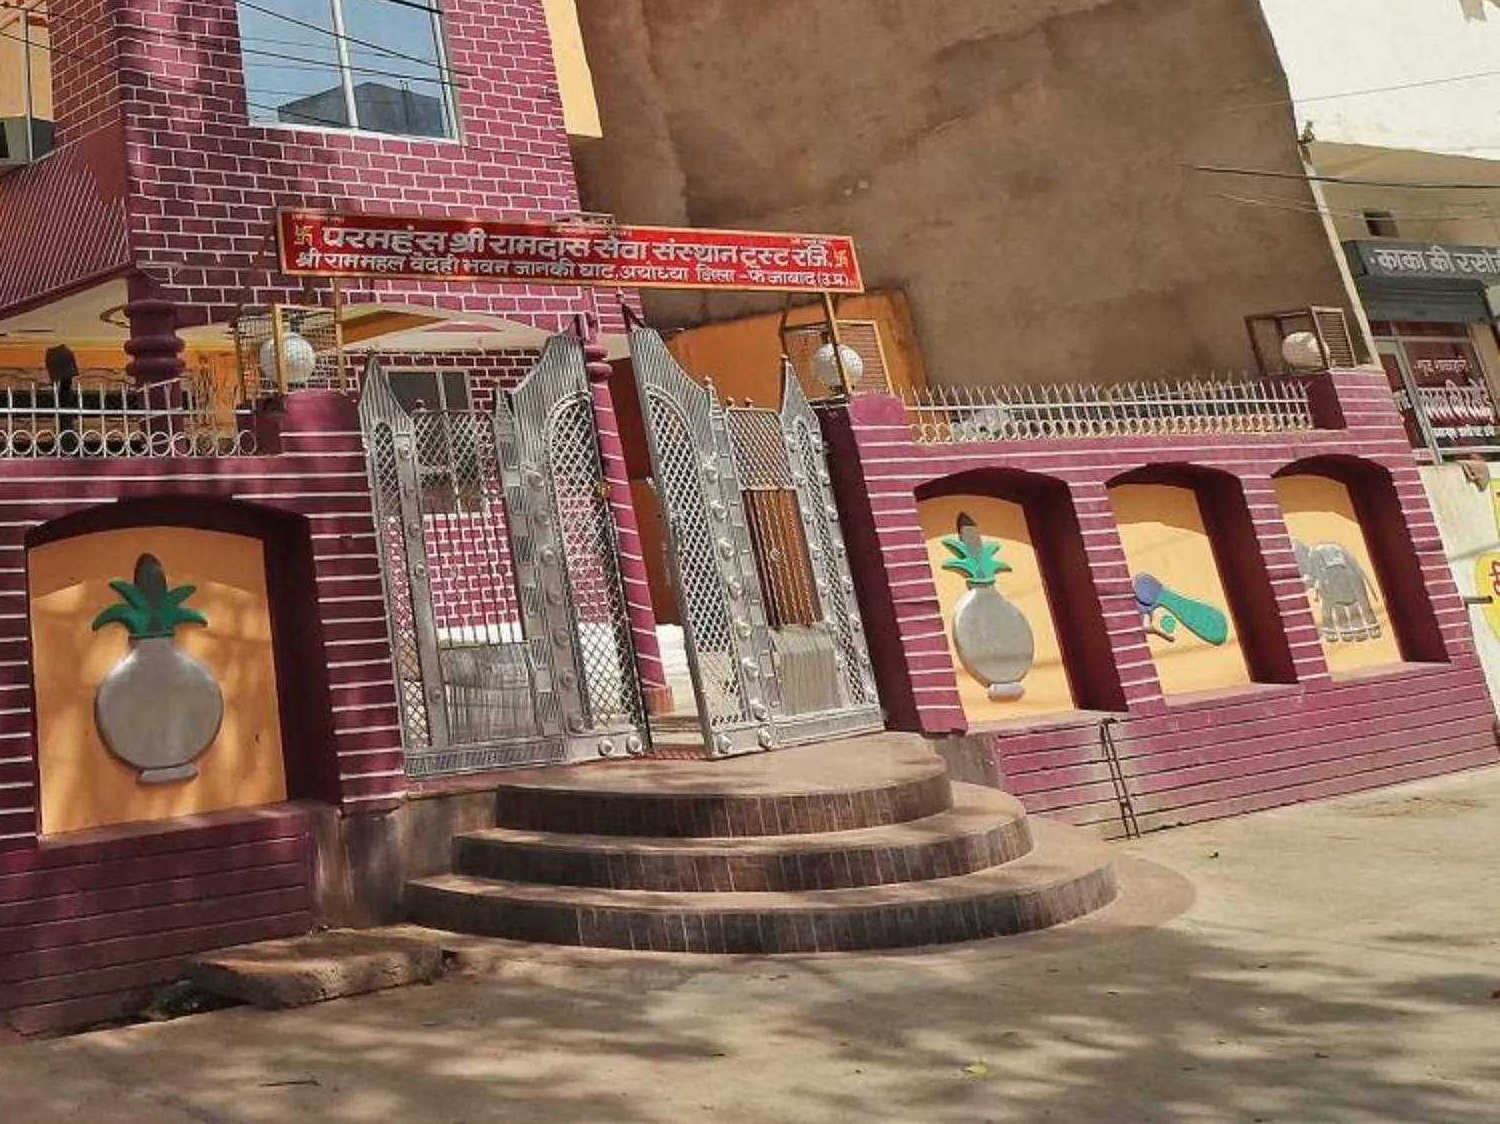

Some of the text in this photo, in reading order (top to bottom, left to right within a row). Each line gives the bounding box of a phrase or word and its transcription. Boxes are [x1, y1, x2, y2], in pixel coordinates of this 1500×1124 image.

[295, 246, 322, 269] श्री
[321, 224, 448, 253] परमहंस
[449, 227, 488, 253] श्री
[592, 234, 650, 260] सेवा
[651, 237, 738, 264] संस्थान
[738, 246, 790, 269] ट्रस्ट
[1425, 244, 1456, 273] की
